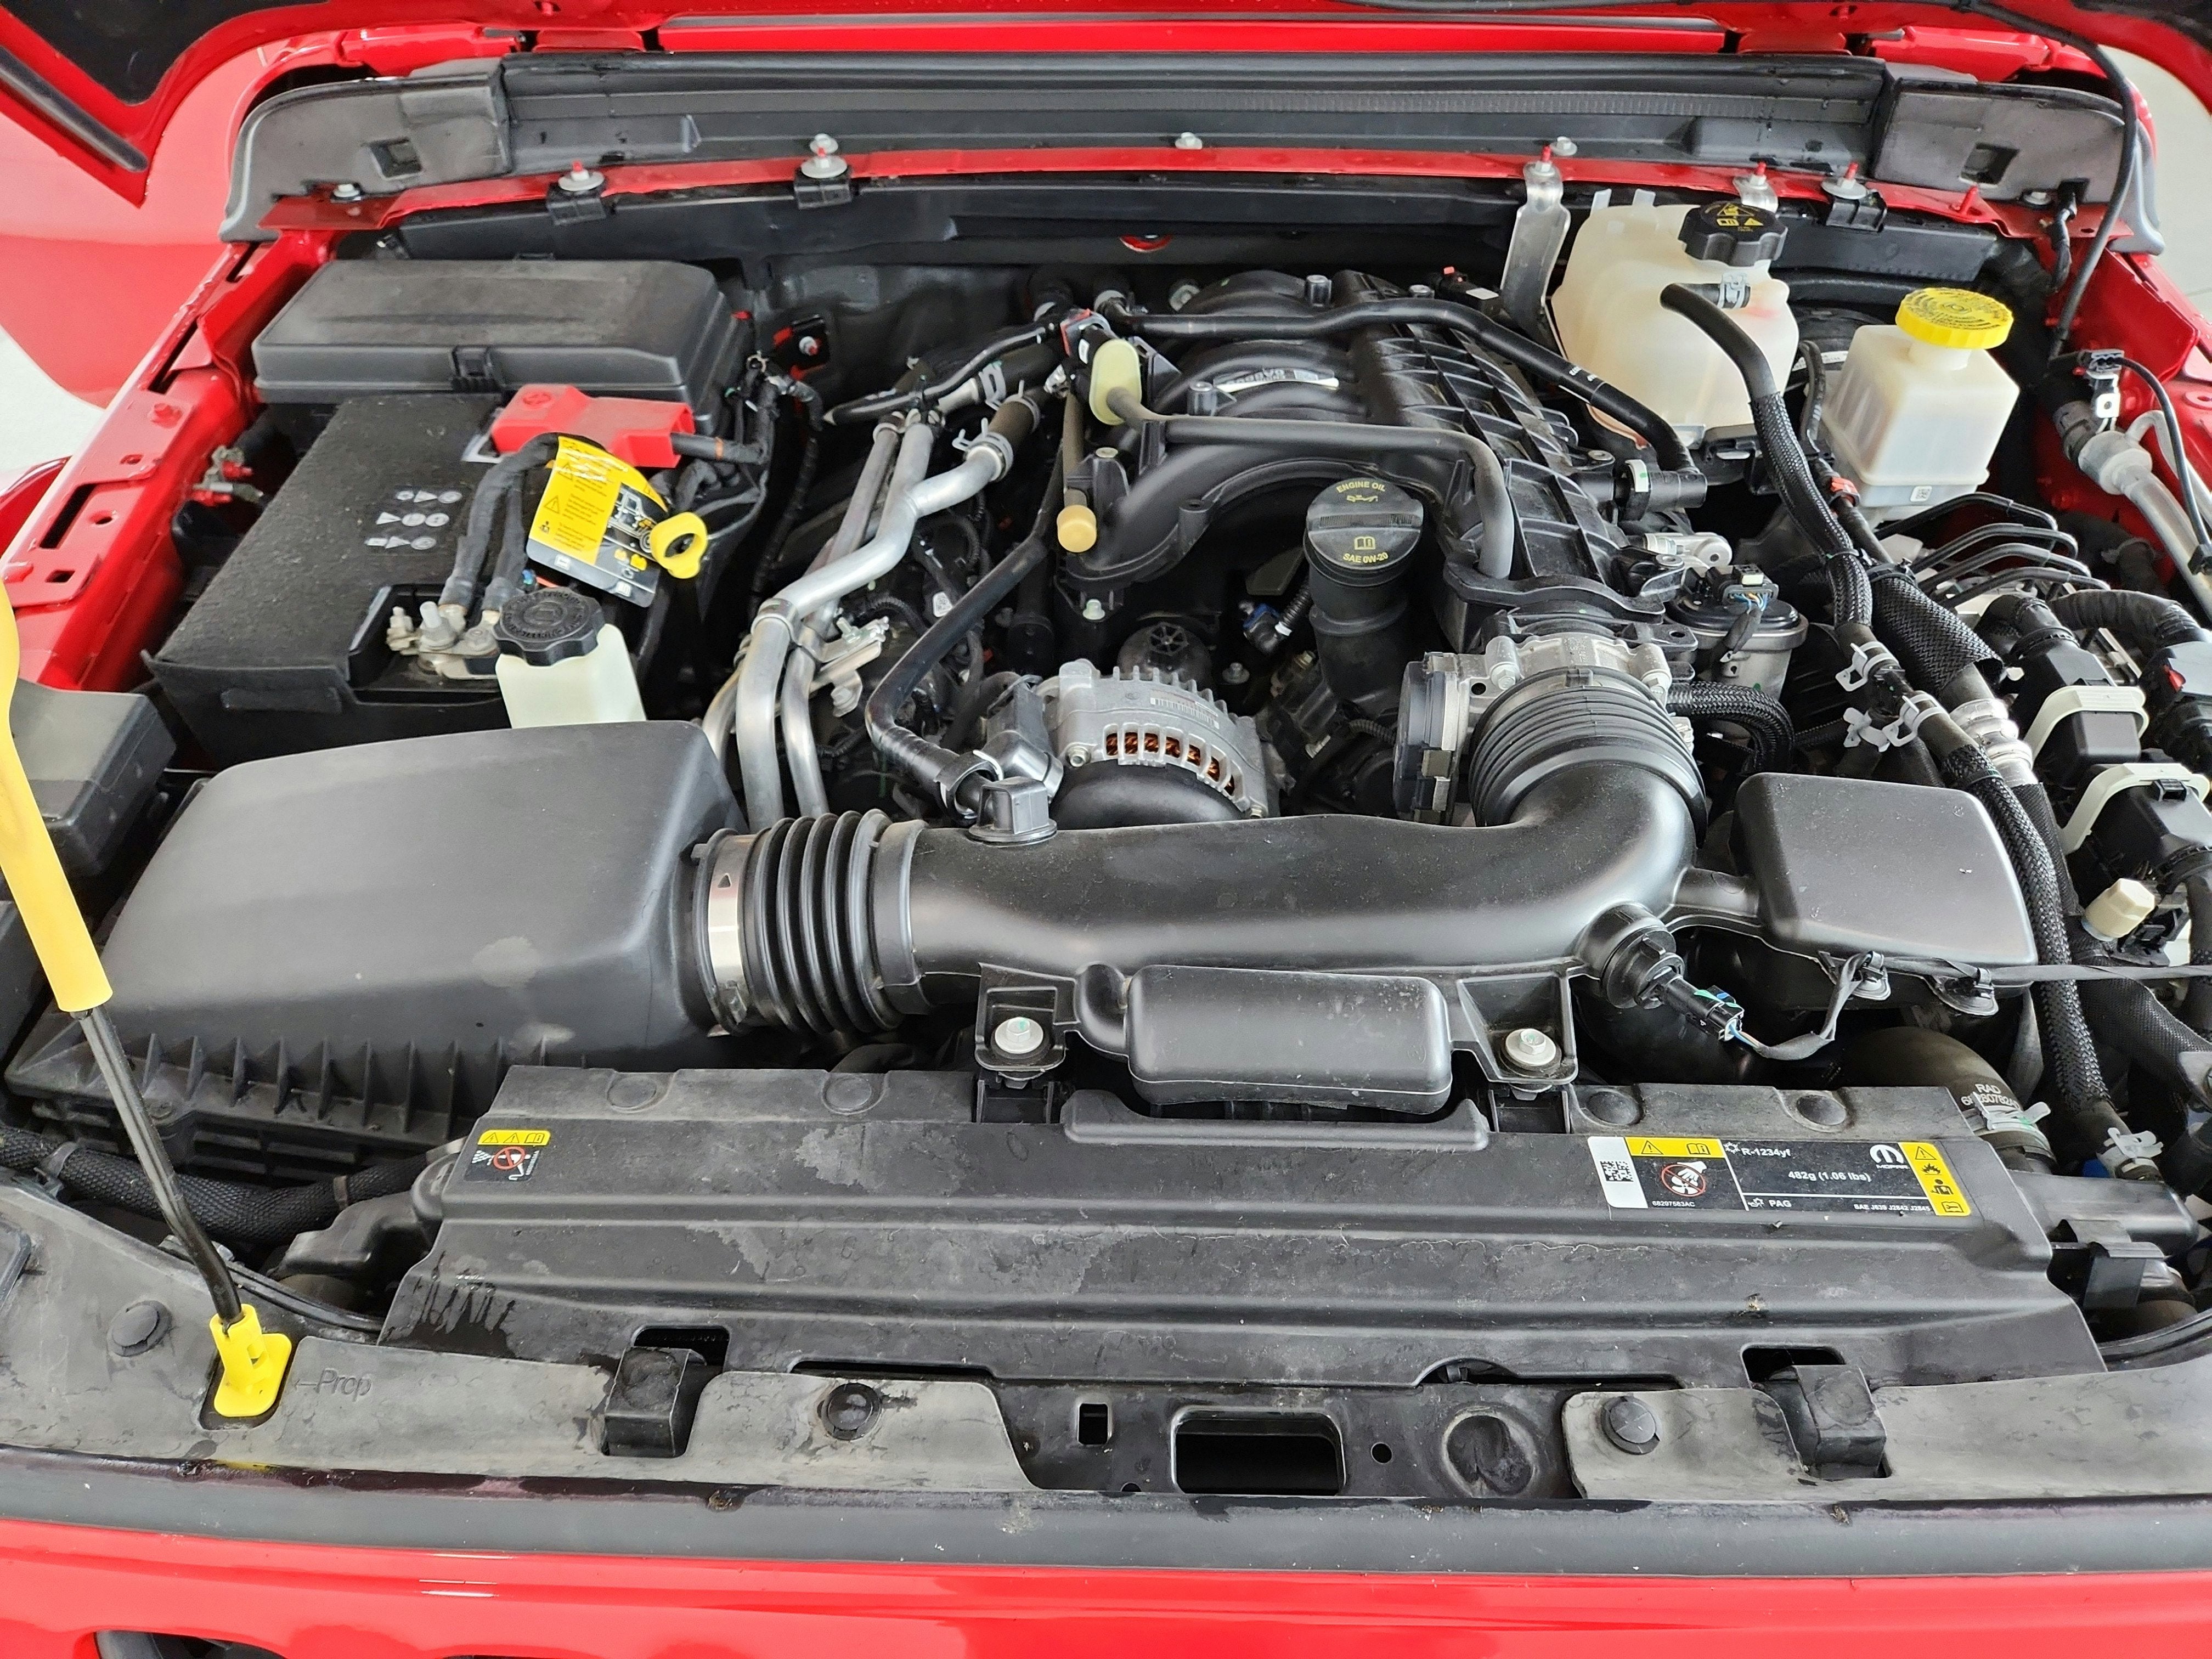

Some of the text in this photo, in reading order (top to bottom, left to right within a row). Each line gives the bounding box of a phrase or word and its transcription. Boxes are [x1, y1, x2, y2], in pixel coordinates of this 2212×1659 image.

[1336, 481, 1385, 493] ENGINE OIL
[1343, 552, 1389, 563] SAE 0W-20
[1975, 1084, 2001, 1094] RAD
[1741, 1148, 1791, 1158] R-1234yf
[1788, 1171, 1872, 1182] 482g (1.06 lbs)
[313, 1368, 372, 1402] Prop
